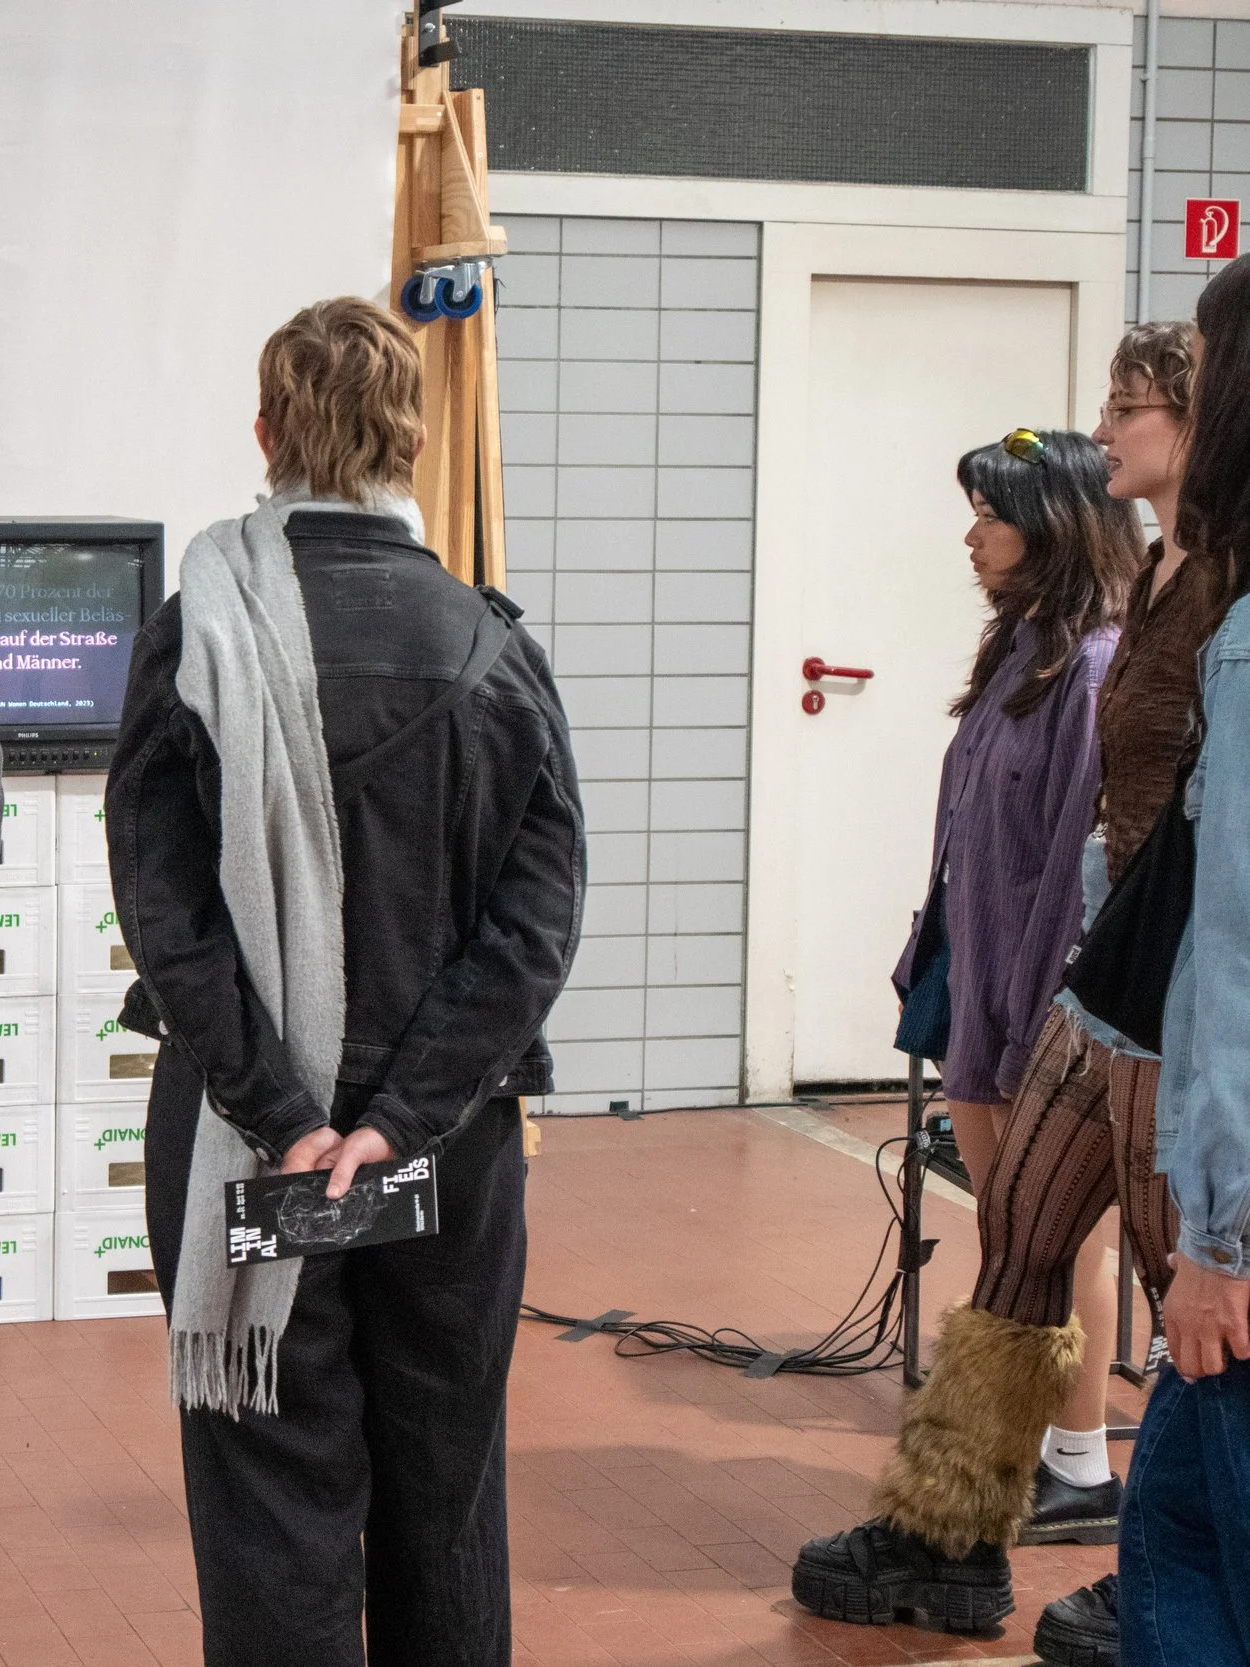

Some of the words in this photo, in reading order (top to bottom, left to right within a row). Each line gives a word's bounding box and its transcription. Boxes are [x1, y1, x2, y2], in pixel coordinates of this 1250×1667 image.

[20, 584, 82, 599] Prozent
[86, 582, 114, 598] der
[4, 607, 76, 623] sexueller
[79, 606, 131, 623] Beläs-
[0, 629, 28, 646] auf
[30, 629, 57, 646] der
[59, 630, 118, 646] Straße
[16, 654, 82, 670] Männer.
[29, 700, 72, 708] Deutschland,
[398, 1162, 414, 1182] EL
[413, 1157, 430, 1181] DS
[382, 1175, 400, 1194] FI
[230, 1226, 247, 1263] LIM
[246, 1227, 262, 1251] IN
[261, 1234, 277, 1257] AL
